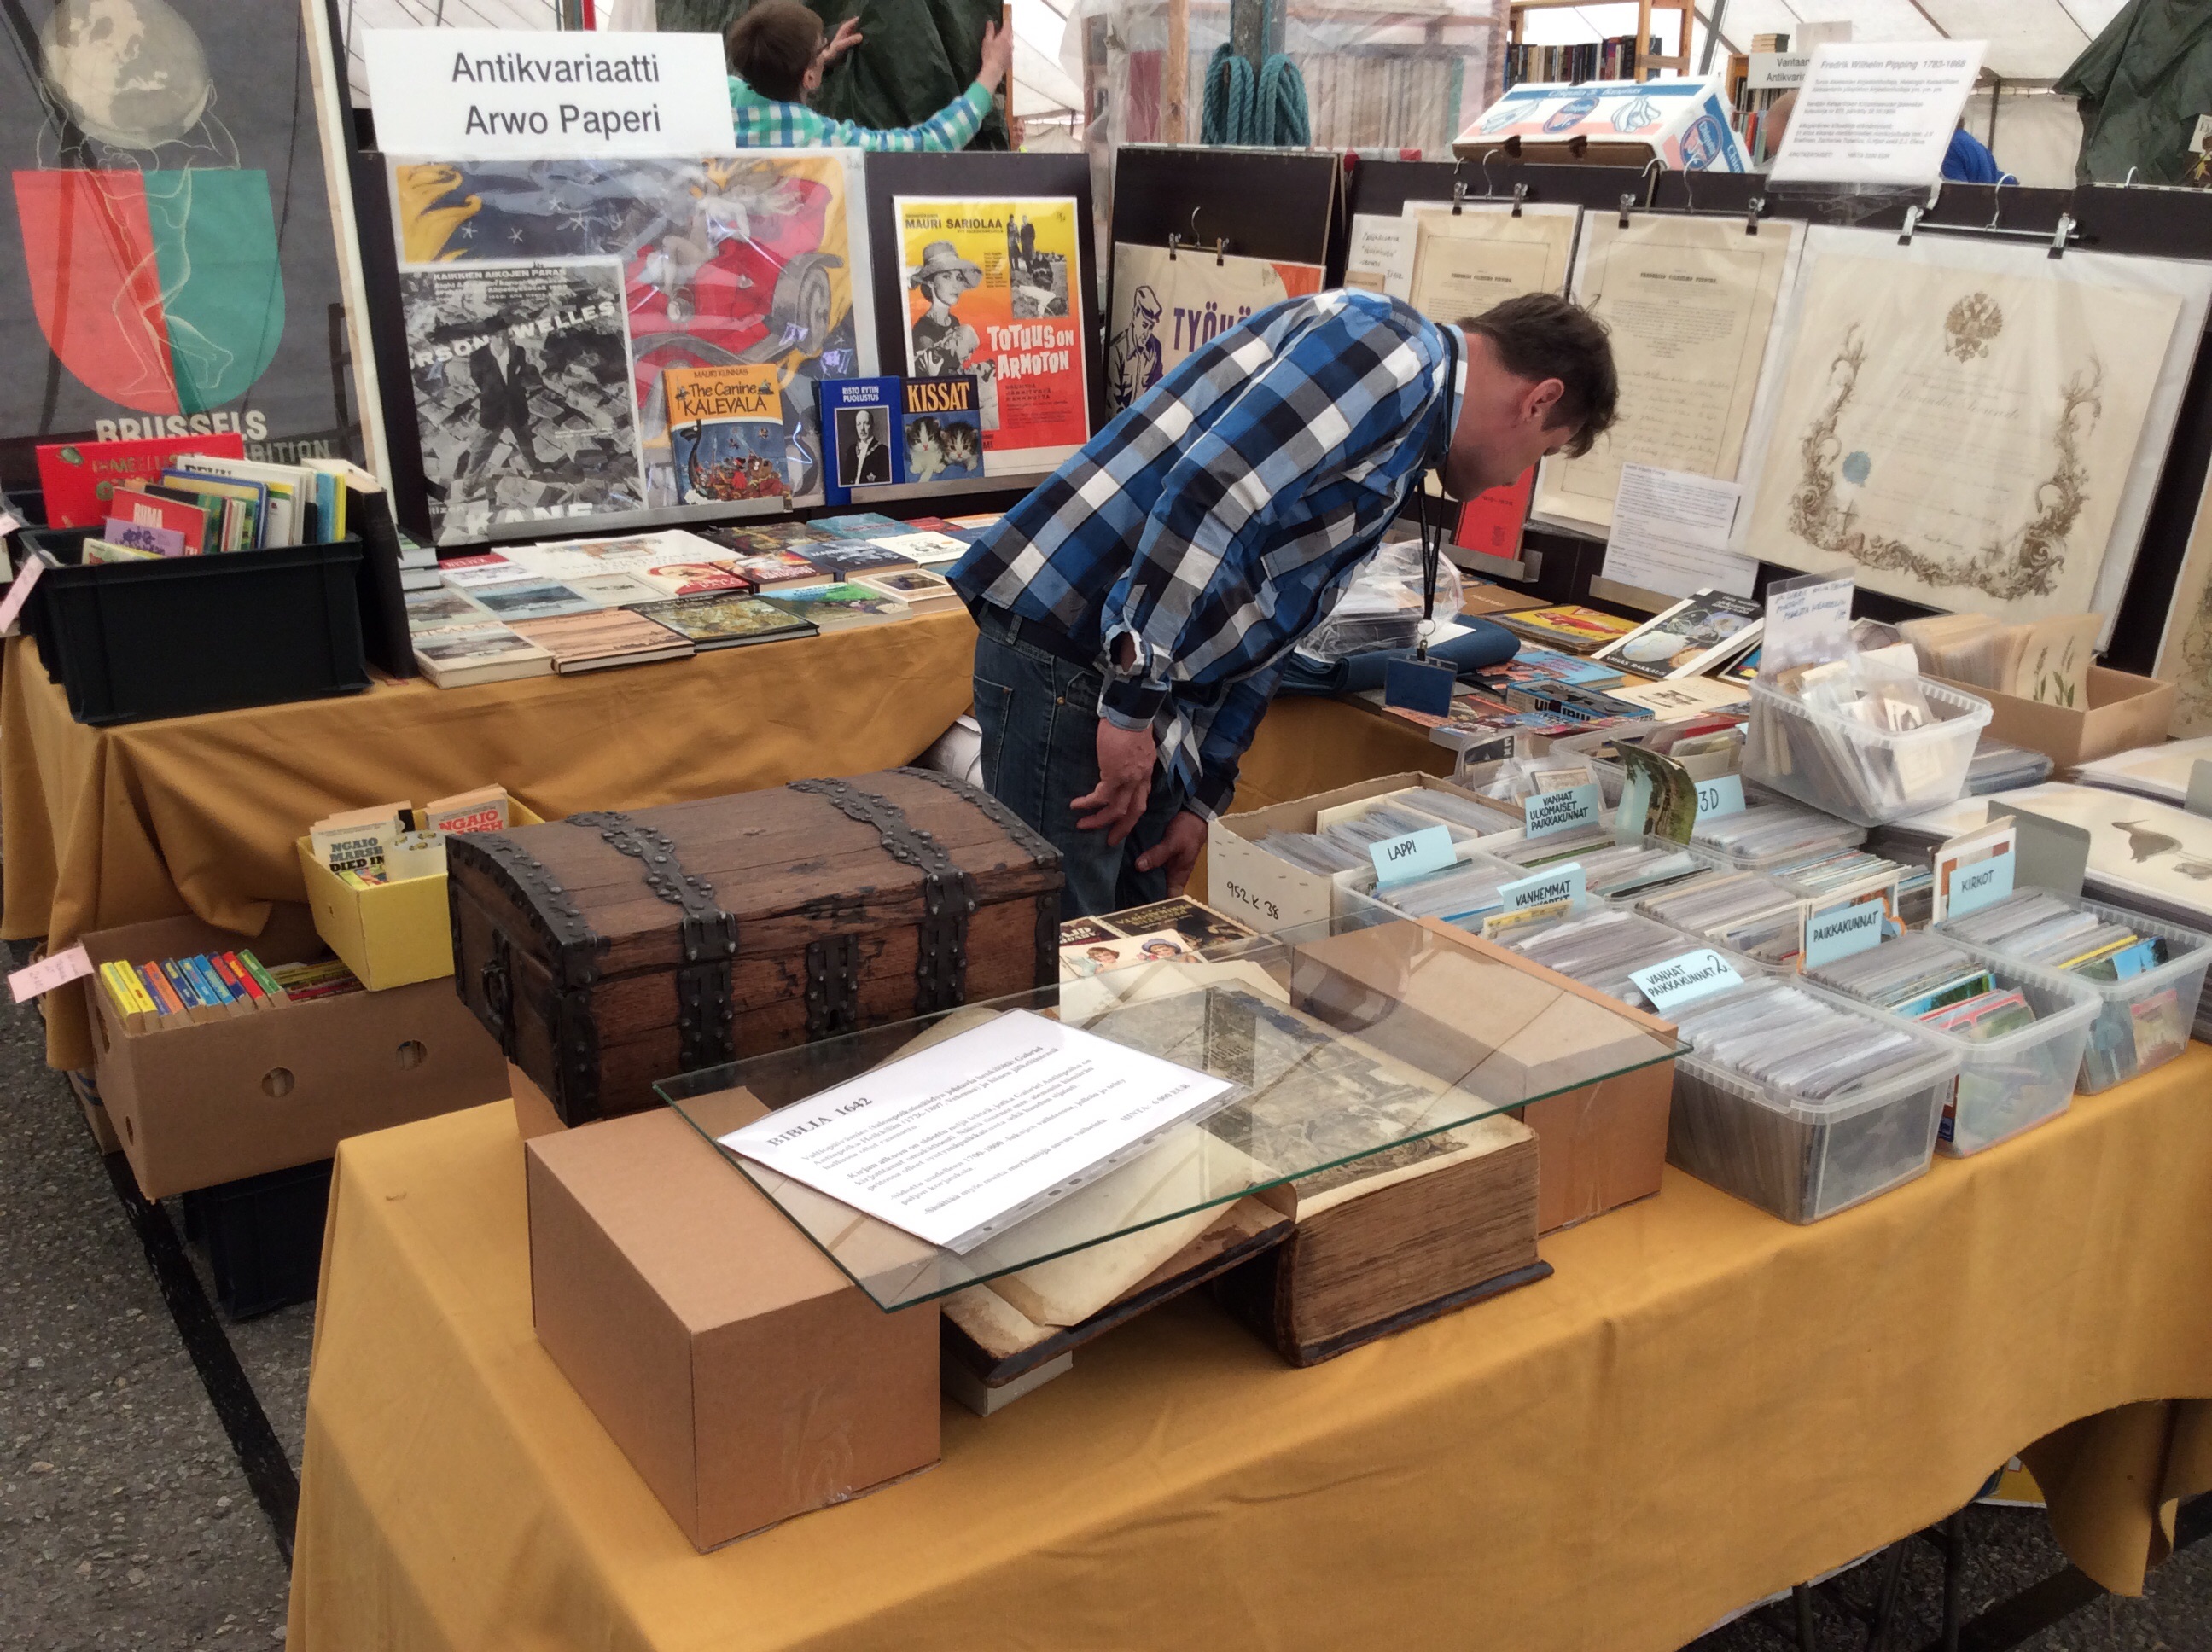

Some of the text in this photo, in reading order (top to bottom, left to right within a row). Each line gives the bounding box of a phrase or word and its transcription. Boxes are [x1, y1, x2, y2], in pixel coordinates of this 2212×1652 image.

[451, 51, 661, 84] Antikvariaatti
[1885, 60, 1918, 70] Pipping
[464, 103, 661, 141] Arwo Paperi
[905, 218, 1003, 230] MAURI SARIOLAA
[434, 271, 483, 281] KAIKKIEN
[485, 270, 530, 279] AIKOJEN
[509, 300, 616, 340] WELLES
[987, 323, 1074, 352] TOTUUS ON
[694, 369, 748, 378] MAURI KUNNAS
[998, 350, 1069, 381] ARMOTON
[690, 381, 758, 398] The Canine
[841, 387, 859, 395] RISTO
[842, 393, 880, 403] PUOLUSTUS
[906, 381, 971, 414] KISSAT
[684, 395, 767, 416] KALEVALA
[96, 410, 268, 444] BRUSSELS
[1542, 790, 1575, 806] VANHAT
[1698, 788, 1719, 812] 3D
[439, 809, 499, 831] NGAIO
[1529, 801, 1578, 820] ULKOMAISET
[1531, 806, 1590, 832] PAIKKAKUNNAT
[329, 845, 383, 863] MARSH
[330, 837, 379, 852] NGAIO
[1387, 839, 1417, 862] LAPPI
[329, 855, 385, 872] DIED IN
[1961, 869, 1995, 893] KIRKOT
[1226, 881, 1249, 905] 952
[1264, 900, 1280, 921] 38
[1515, 879, 1572, 907] VANHEMMAT
[1813, 910, 1879, 943] PAIKKAKUNNAT
[1645, 964, 1686, 986] VANHAT
[1647, 966, 1717, 998] PAIKKAKUNNAT
[1013, 1046, 1045, 1061] Gabriel
[765, 1096, 873, 1146] BIBLIA 1642
